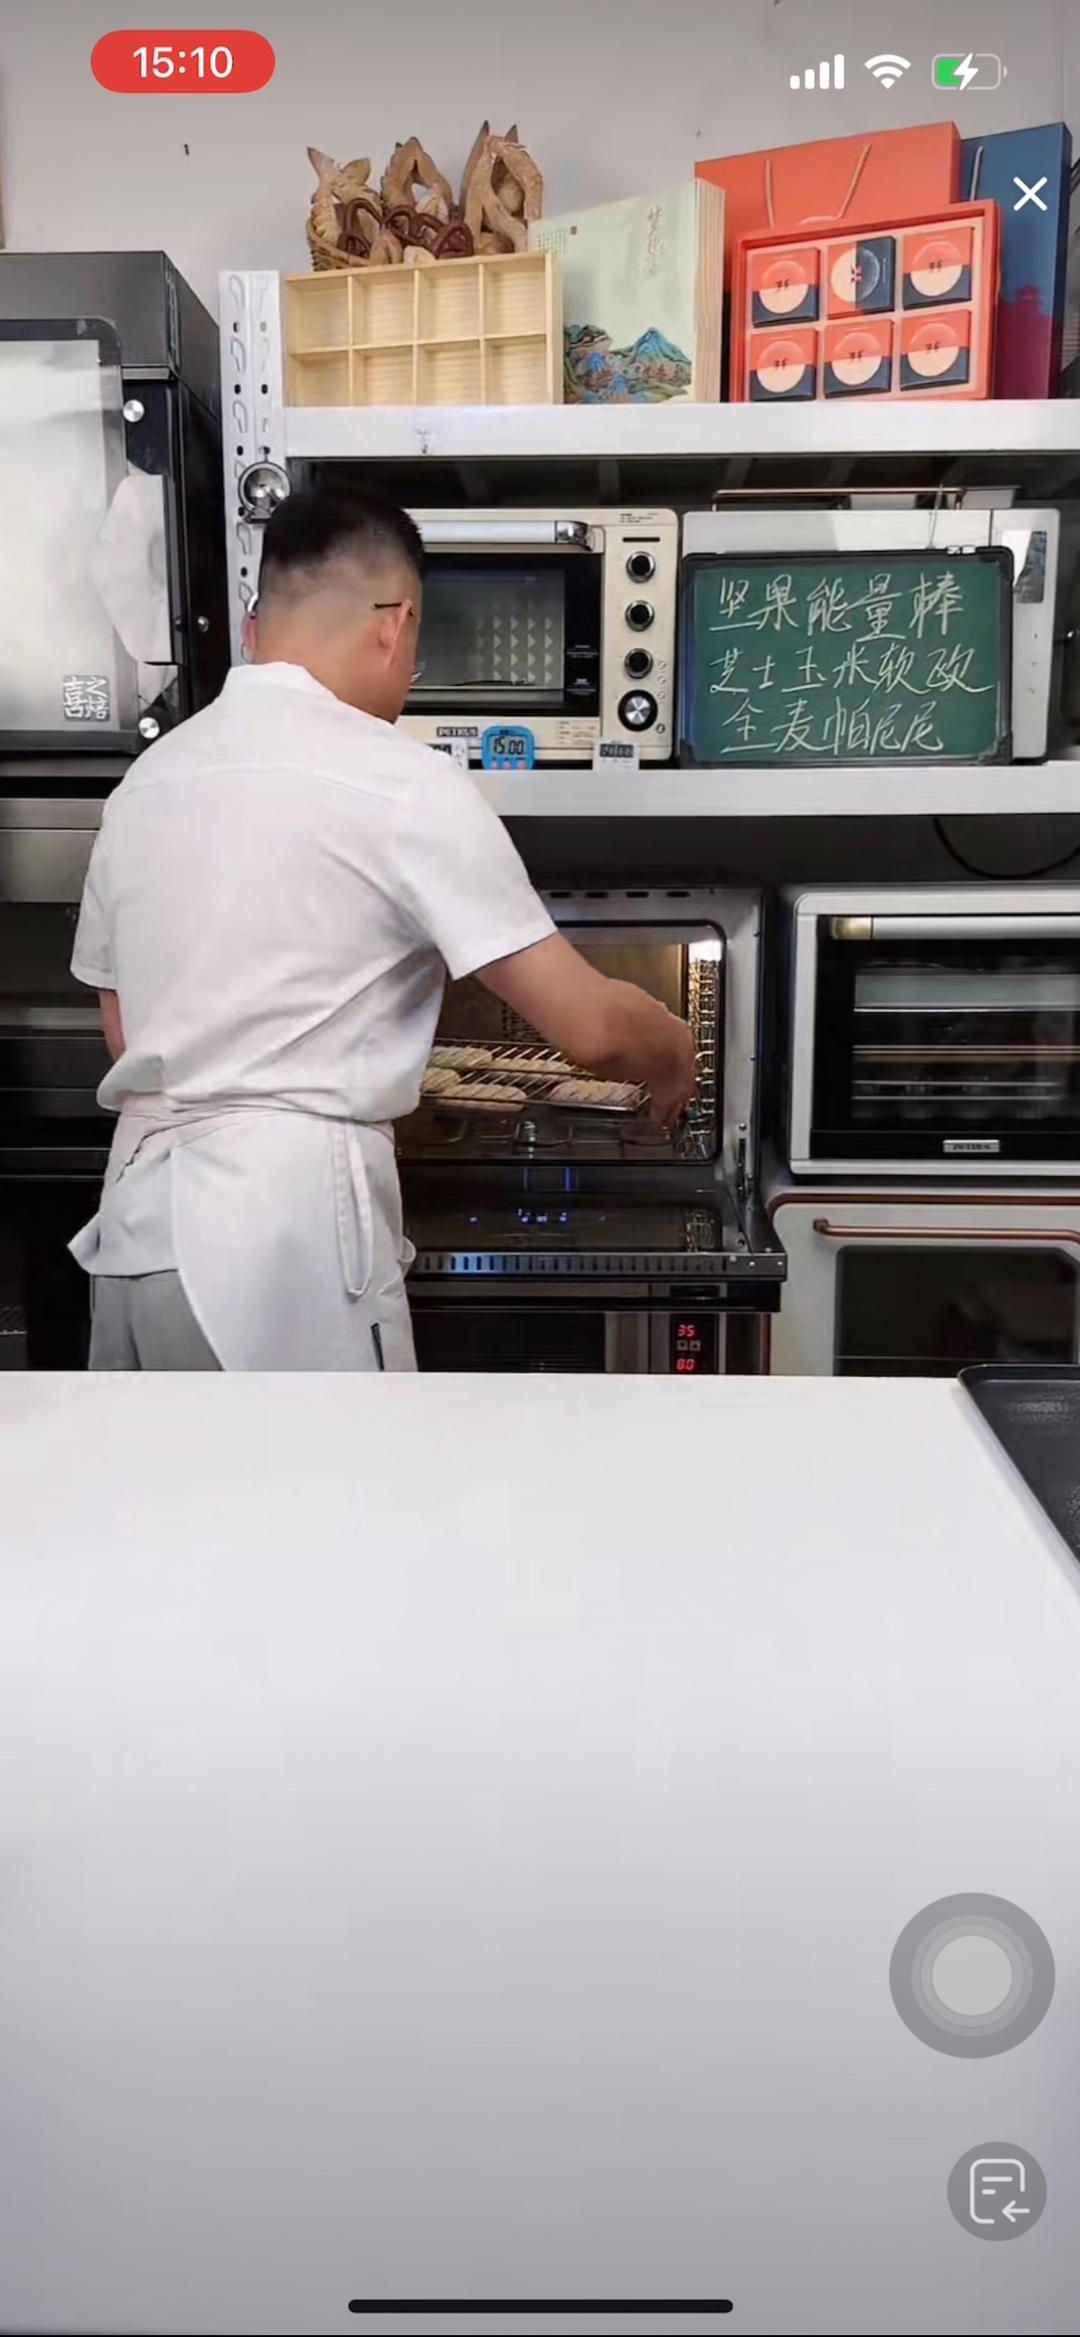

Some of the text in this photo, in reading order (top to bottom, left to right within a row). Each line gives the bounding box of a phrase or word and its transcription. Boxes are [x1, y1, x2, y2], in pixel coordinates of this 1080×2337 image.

[709, 571, 964, 642] 坚果能量棒
[709, 643, 995, 694] 芝士玉米软欧
[720, 697, 944, 756] 全麦帕尼尼
[677, 1324, 695, 1337] 35
[676, 1358, 695, 1370] 80
